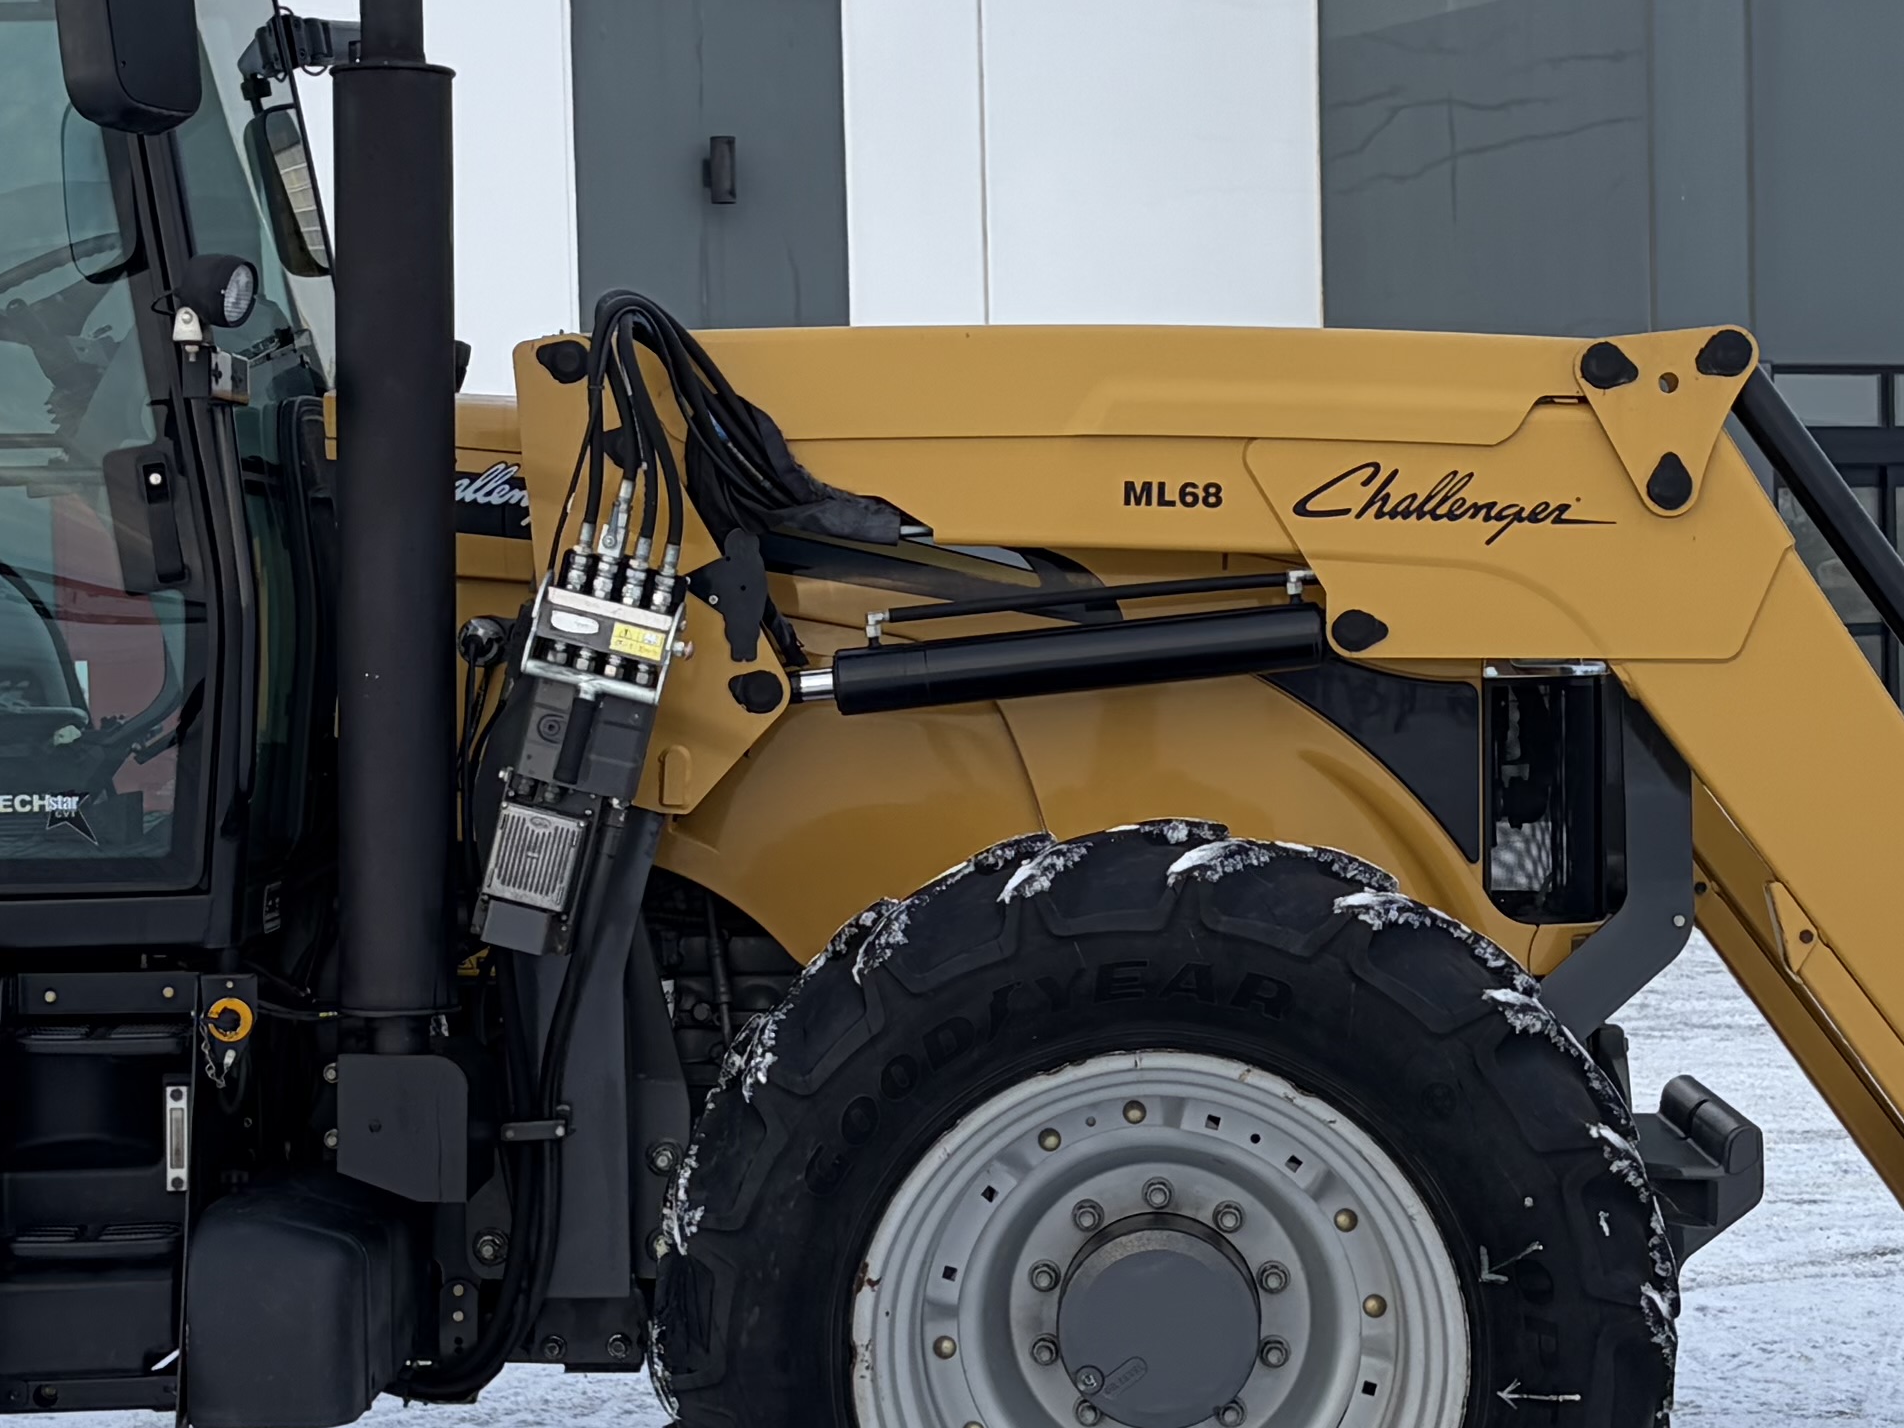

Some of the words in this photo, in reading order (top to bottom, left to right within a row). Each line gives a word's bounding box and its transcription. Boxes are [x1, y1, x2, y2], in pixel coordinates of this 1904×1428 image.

[1123, 480, 1223, 509] ML68
[1292, 461, 1617, 546] Challenger
[803, 959, 1296, 1197] GOODYEAR
